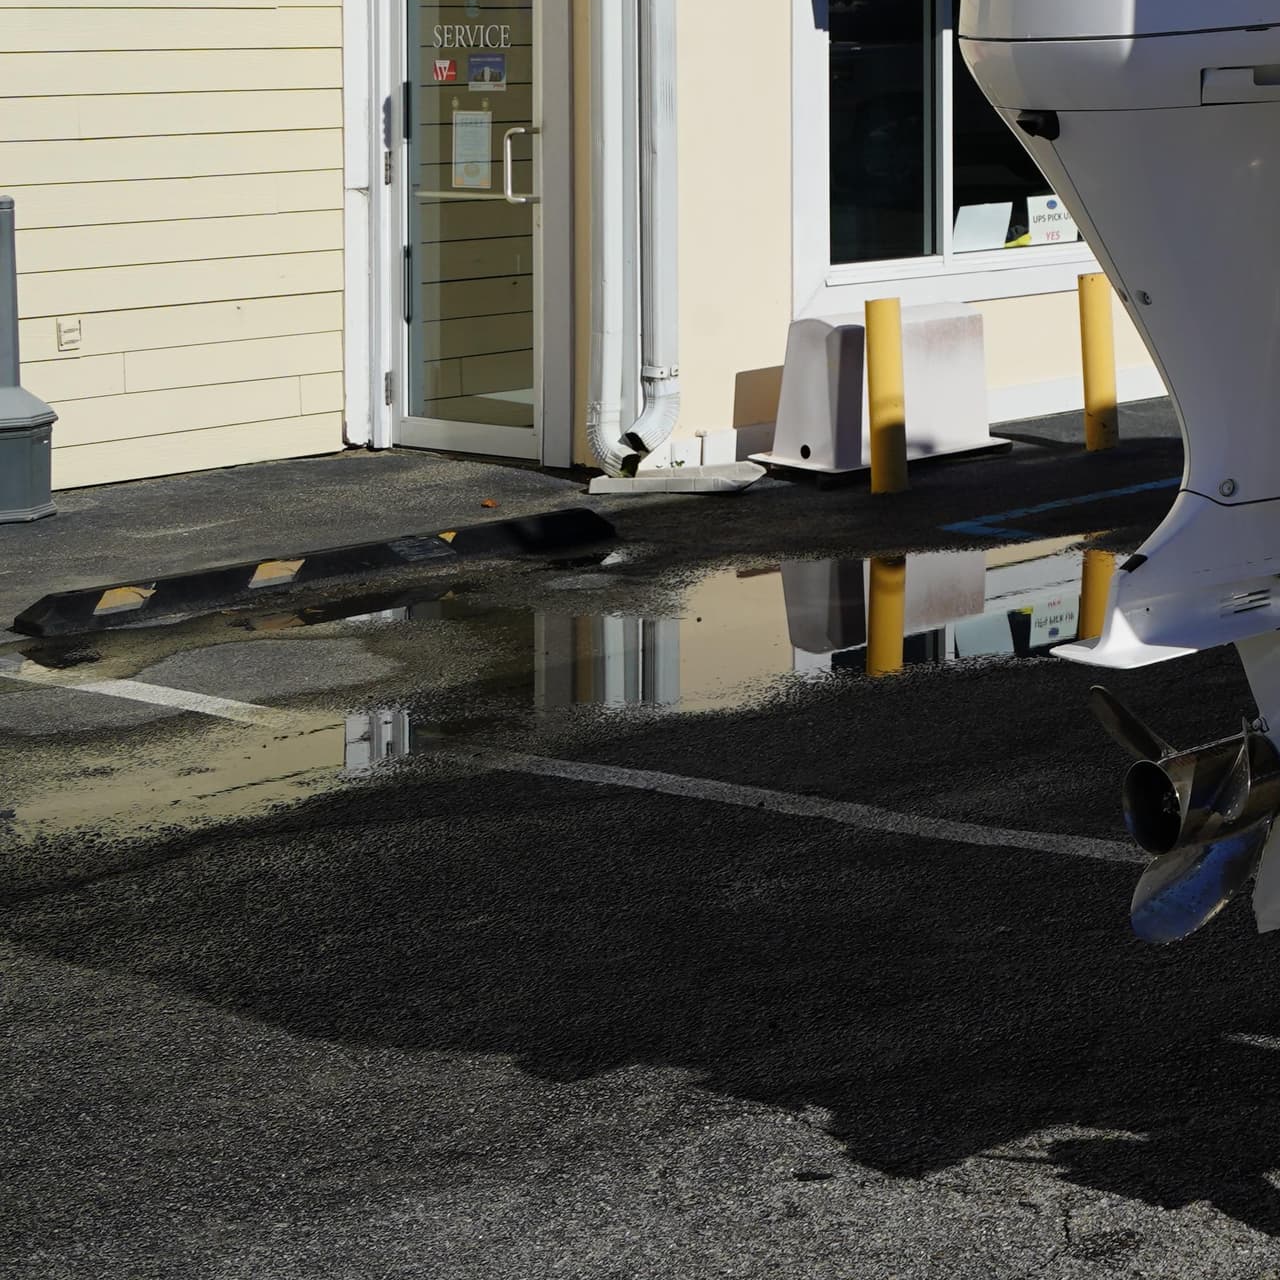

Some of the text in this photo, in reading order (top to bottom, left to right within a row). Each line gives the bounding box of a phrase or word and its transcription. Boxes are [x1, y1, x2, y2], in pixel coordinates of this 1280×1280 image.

[433, 24, 512, 48] SERVICE
[1032, 215, 1046, 223] UPS
[1047, 213, 1062, 222] PICK
[1046, 231, 1060, 240] YES
